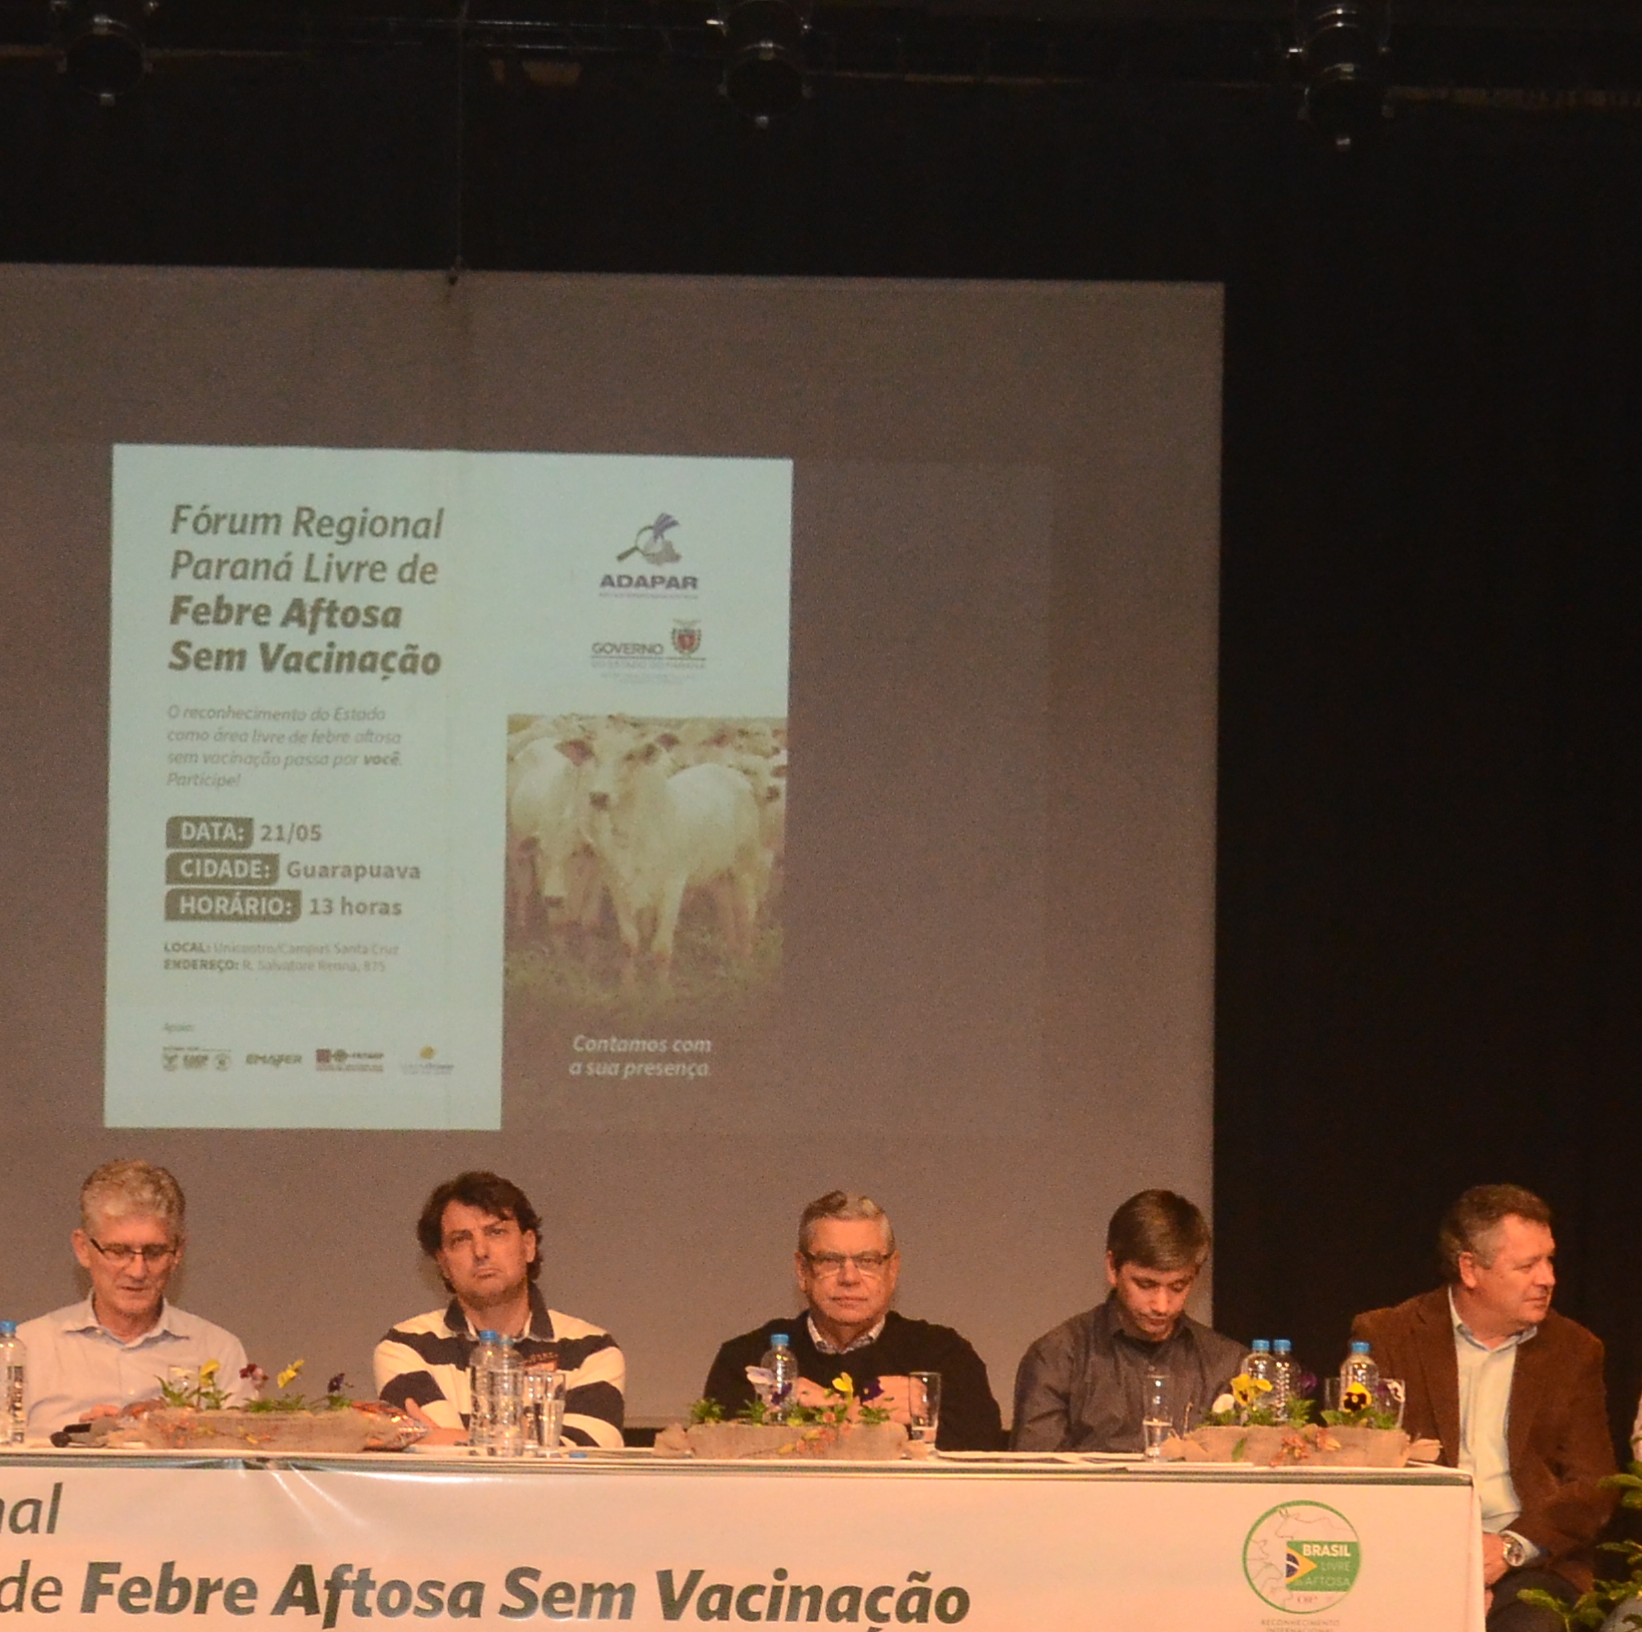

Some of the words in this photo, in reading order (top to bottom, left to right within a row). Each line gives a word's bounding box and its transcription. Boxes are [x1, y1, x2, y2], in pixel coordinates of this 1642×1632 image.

[170, 505, 282, 537] Fórum
[292, 506, 444, 546] Regional
[170, 550, 293, 583] Paraná
[303, 553, 388, 585] Livre
[398, 555, 439, 585] de
[600, 574, 698, 590] ADAPAR
[169, 596, 272, 628] Febre
[280, 598, 403, 636] Aftosa
[591, 642, 664, 656] GOVERNO
[168, 641, 248, 672] Sem
[257, 642, 442, 682] Vacinação
[167, 704, 180, 719] O
[183, 704, 307, 722] reconhecimento
[310, 706, 330, 722] do
[333, 706, 386, 722] Estado
[167, 730, 210, 743] como
[213, 727, 249, 744] área
[252, 729, 285, 745] livre
[288, 729, 309, 745] de
[311, 730, 350, 745] febre
[167, 751, 200, 765] sem
[202, 751, 281, 768] vacinação
[283, 754, 330, 770] passa
[332, 754, 359, 769] por
[166, 772, 242, 788] Participe!
[180, 821, 245, 844] DATA:
[261, 821, 323, 847] 21/05
[180, 857, 272, 881] CIDADE:
[287, 859, 421, 887] Guarapuava
[178, 889, 294, 917] HORÁRIO:
[309, 896, 335, 916] 13
[340, 896, 403, 917] horas
[163, 942, 212, 954] LOCAL:
[163, 959, 240, 973] ENDEREÇO:
[574, 1033, 665, 1056] Contamos
[672, 1036, 712, 1055] com
[568, 1064, 581, 1076] a
[587, 1064, 619, 1077] sua
[623, 1061, 712, 1081] presença.
[1302, 1543, 1351, 1557] BRASIL
[79, 1561, 258, 1616] Febre
[270, 1563, 485, 1631] Aftosa
[498, 1566, 635, 1621] Sem
